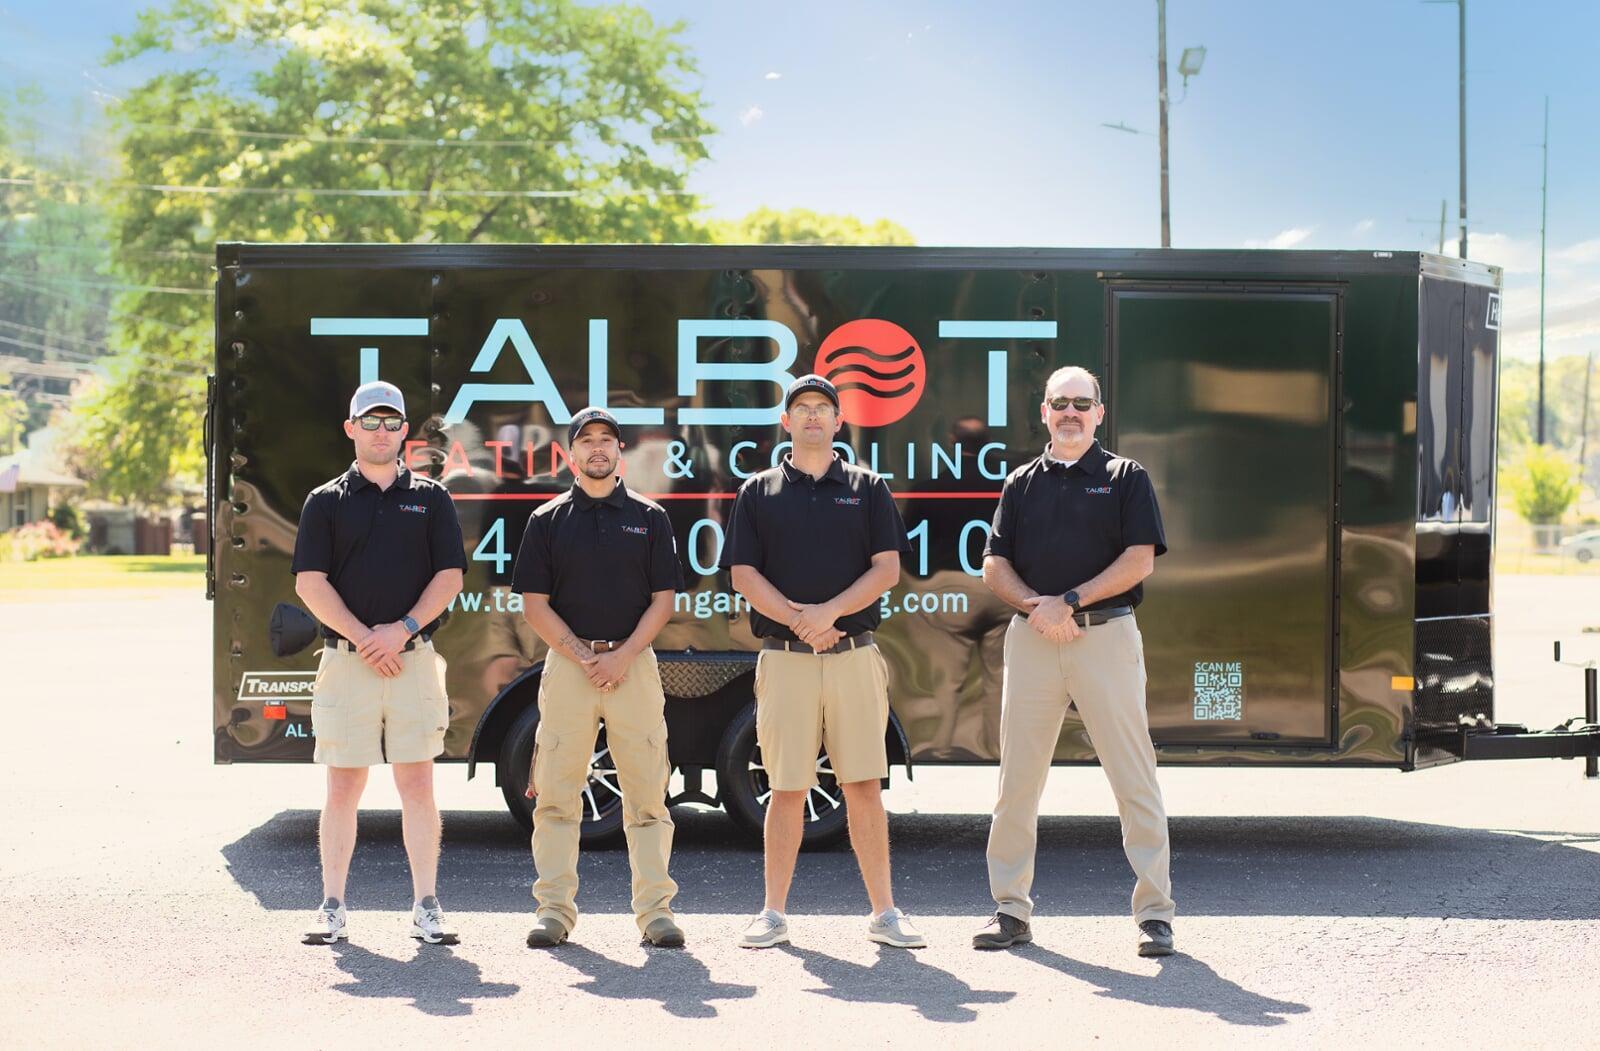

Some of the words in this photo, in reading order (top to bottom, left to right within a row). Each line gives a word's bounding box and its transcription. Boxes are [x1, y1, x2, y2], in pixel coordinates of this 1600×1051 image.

[310, 317, 1058, 427] TALBOT
[404, 440, 626, 478] EATIN
[662, 441, 695, 478] &
[1195, 662, 1223, 672] SCAN
[1226, 662, 1241, 672] ME
[285, 723, 308, 738] AL
